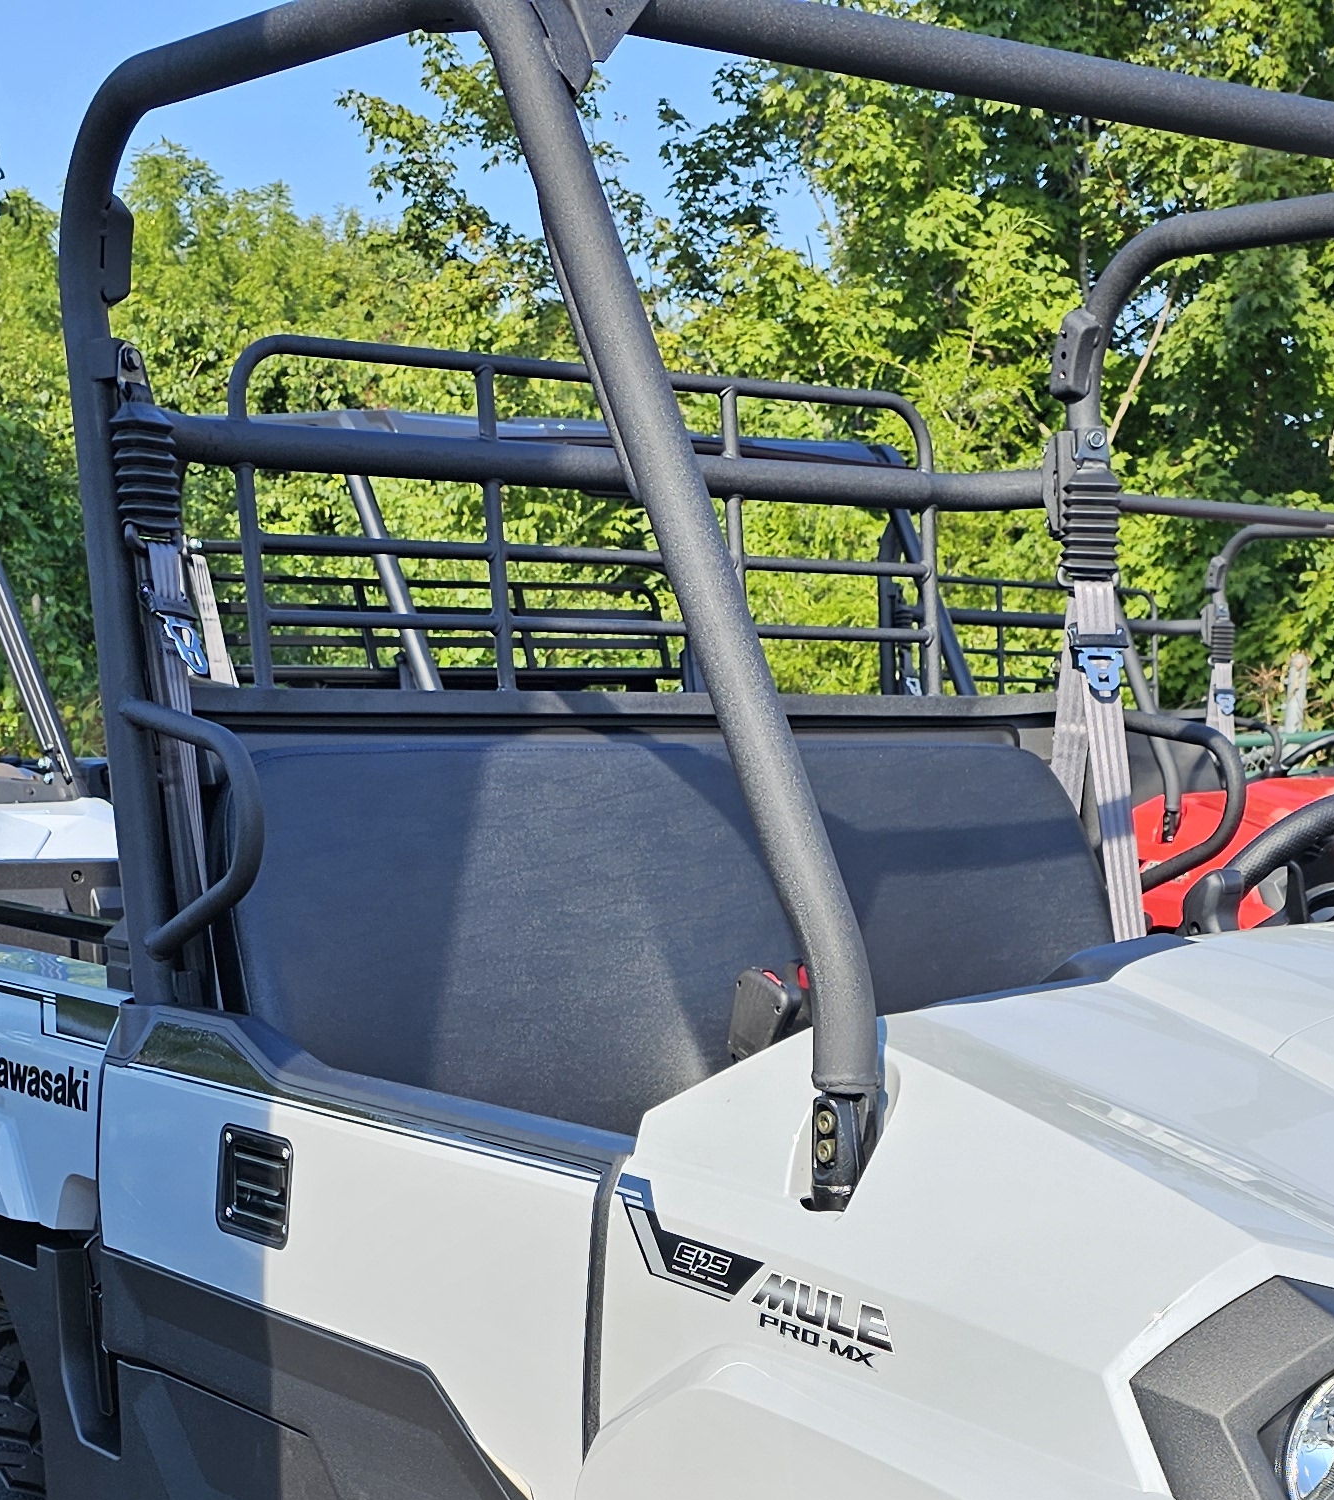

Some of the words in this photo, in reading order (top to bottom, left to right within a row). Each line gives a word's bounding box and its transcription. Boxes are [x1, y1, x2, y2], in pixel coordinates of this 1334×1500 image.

[672, 1241, 733, 1276] EPS
[748, 1270, 896, 1355] MULE
[758, 1312, 877, 1369] PRO-MX
